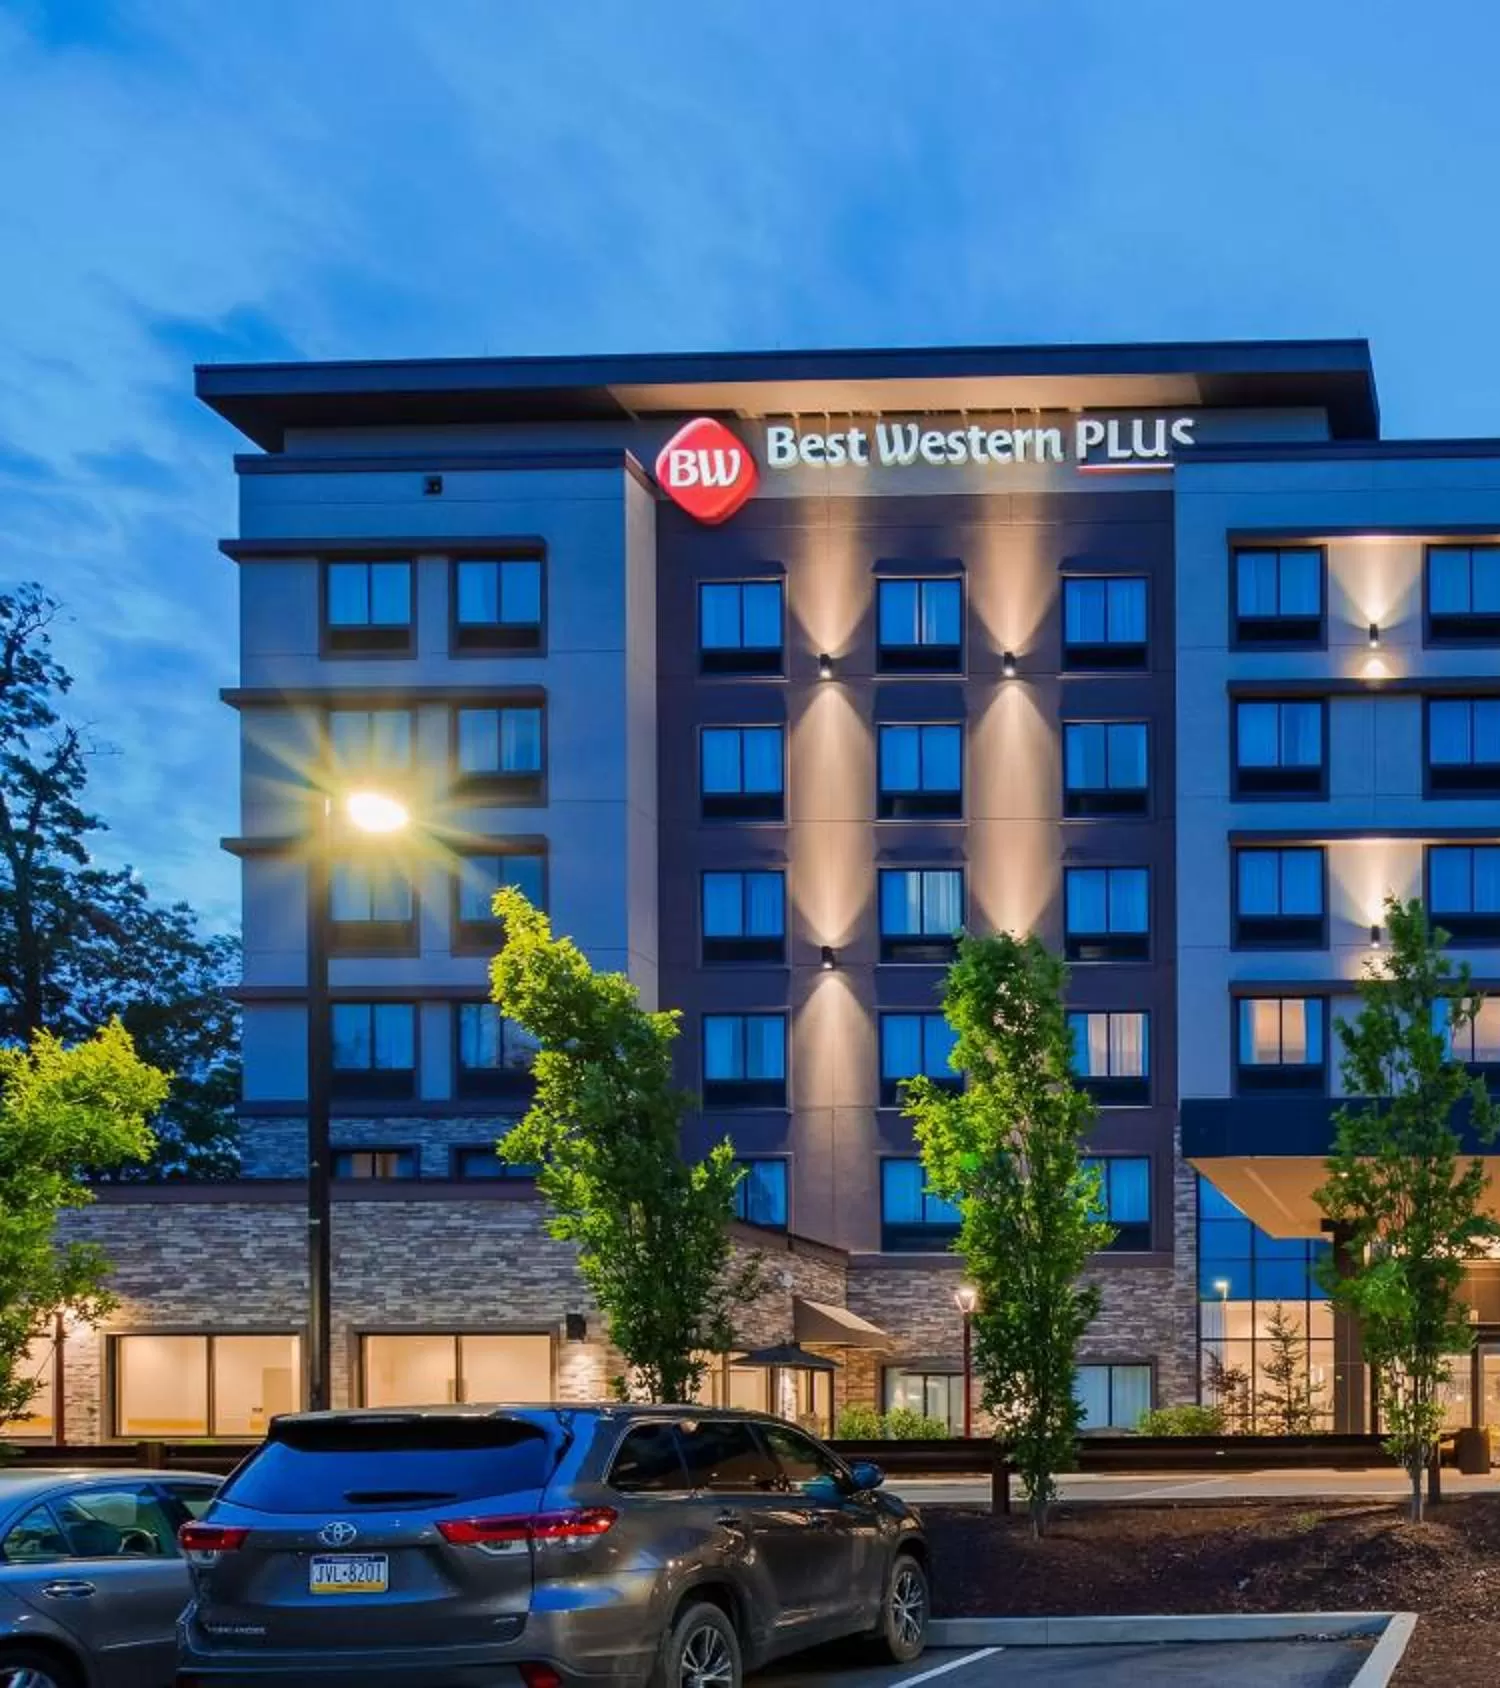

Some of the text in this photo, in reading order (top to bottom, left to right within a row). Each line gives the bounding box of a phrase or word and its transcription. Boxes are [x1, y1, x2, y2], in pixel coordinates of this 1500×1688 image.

[767, 417, 1196, 469] Best Western PLUS
[669, 448, 741, 487] BW
